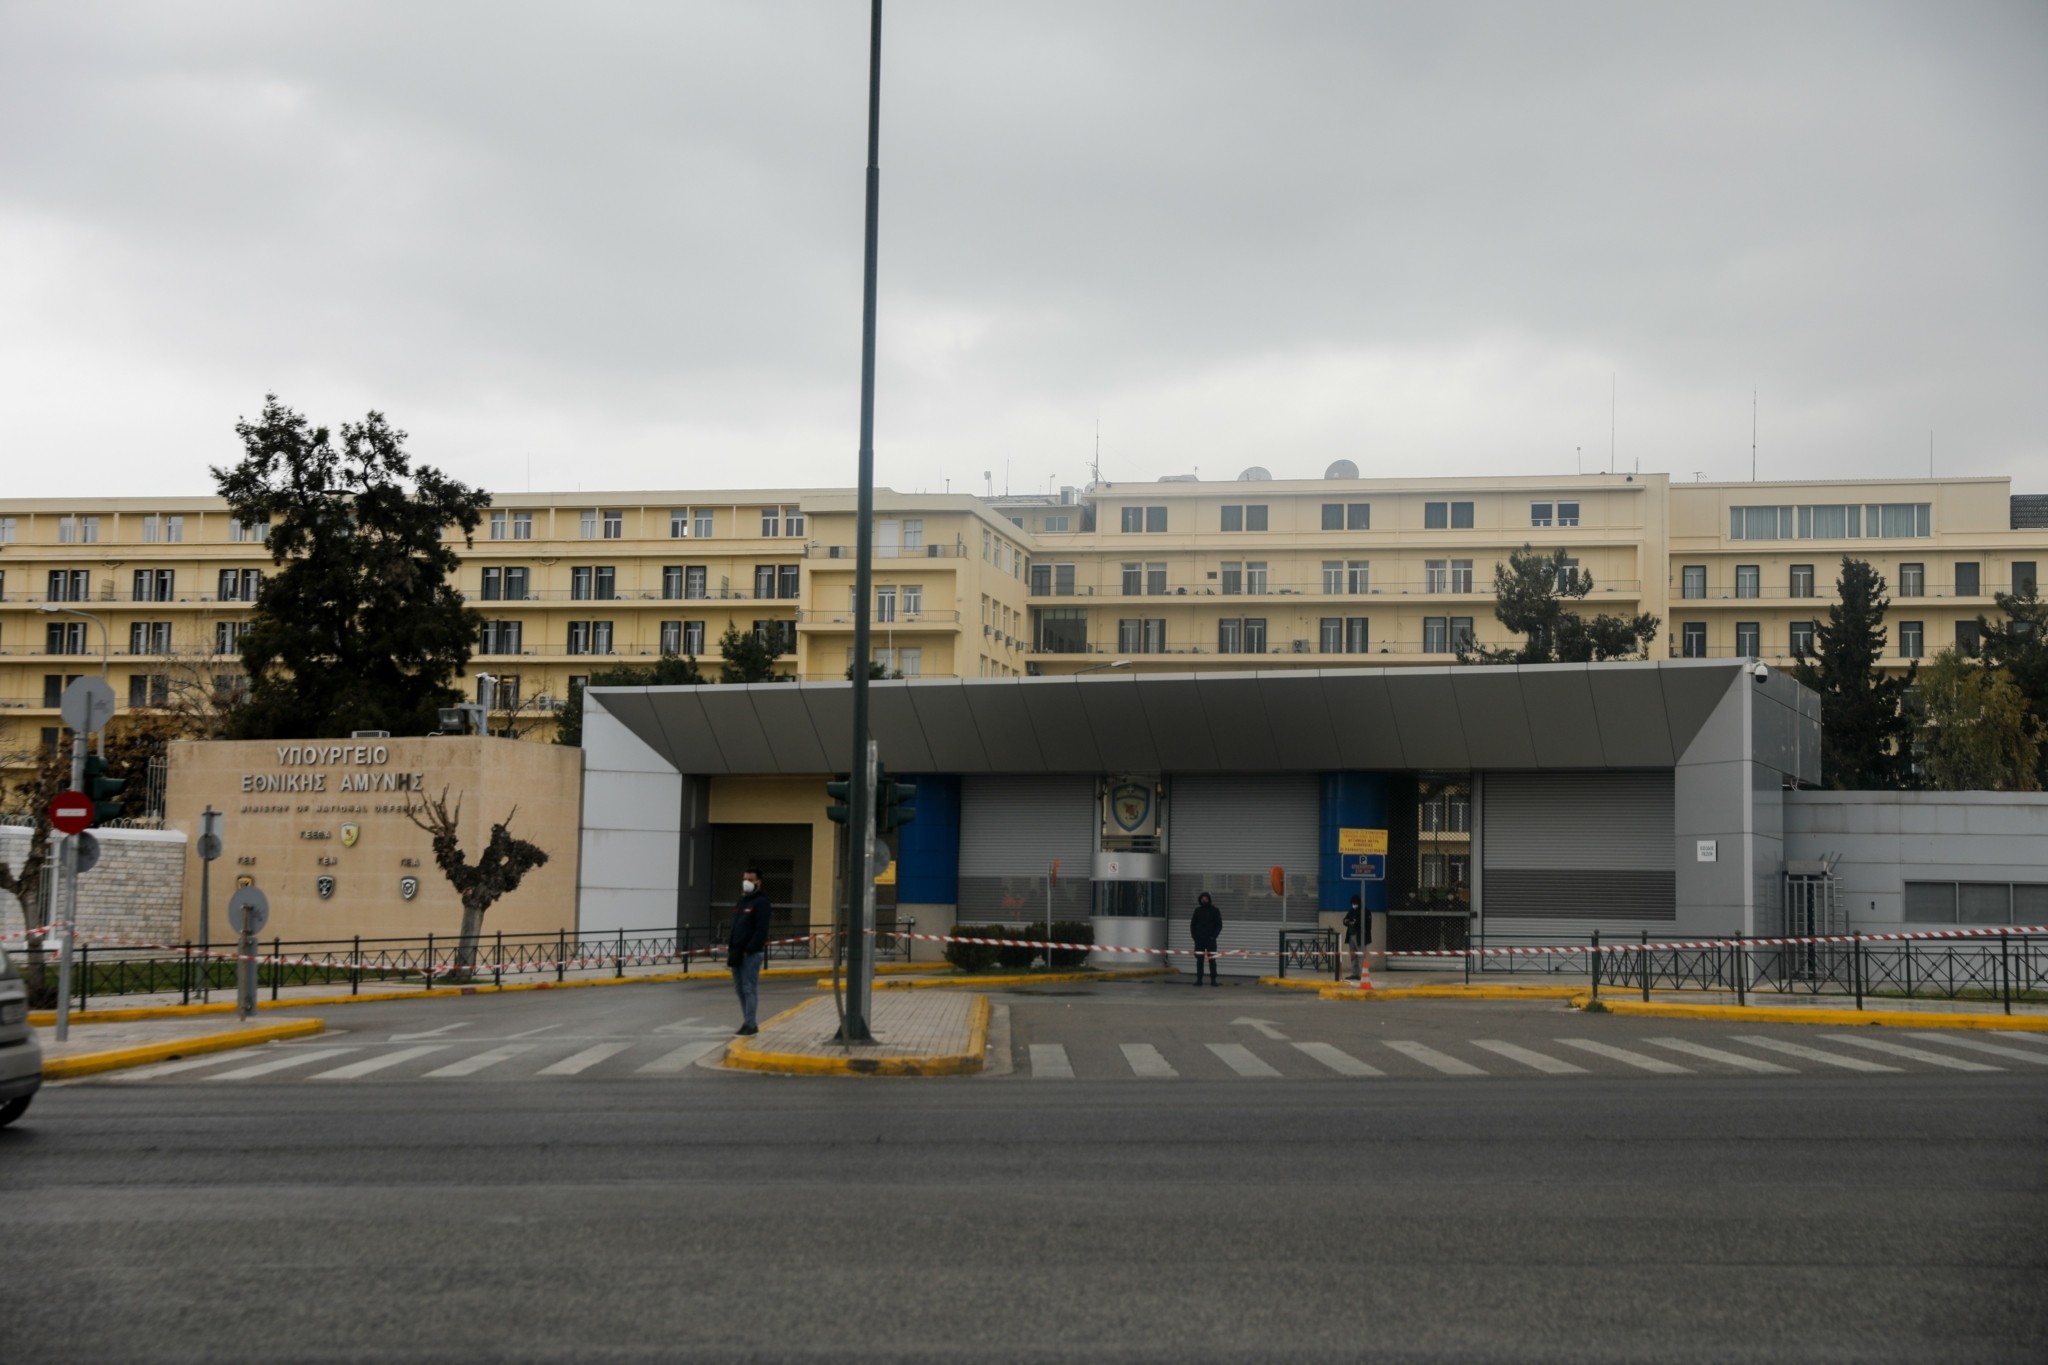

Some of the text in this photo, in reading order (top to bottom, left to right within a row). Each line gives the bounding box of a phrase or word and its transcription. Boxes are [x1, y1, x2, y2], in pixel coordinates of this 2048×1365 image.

[276, 746, 388, 765] ΥΠΟΥΡΓΕΙΟ
[241, 773, 424, 793] ΕΘΝΙΚΗΣ ΑΜΥΝΗΣ
[241, 805, 290, 814] MINISTRY
[297, 805, 309, 814] OF
[315, 805, 368, 813] NATIONAL
